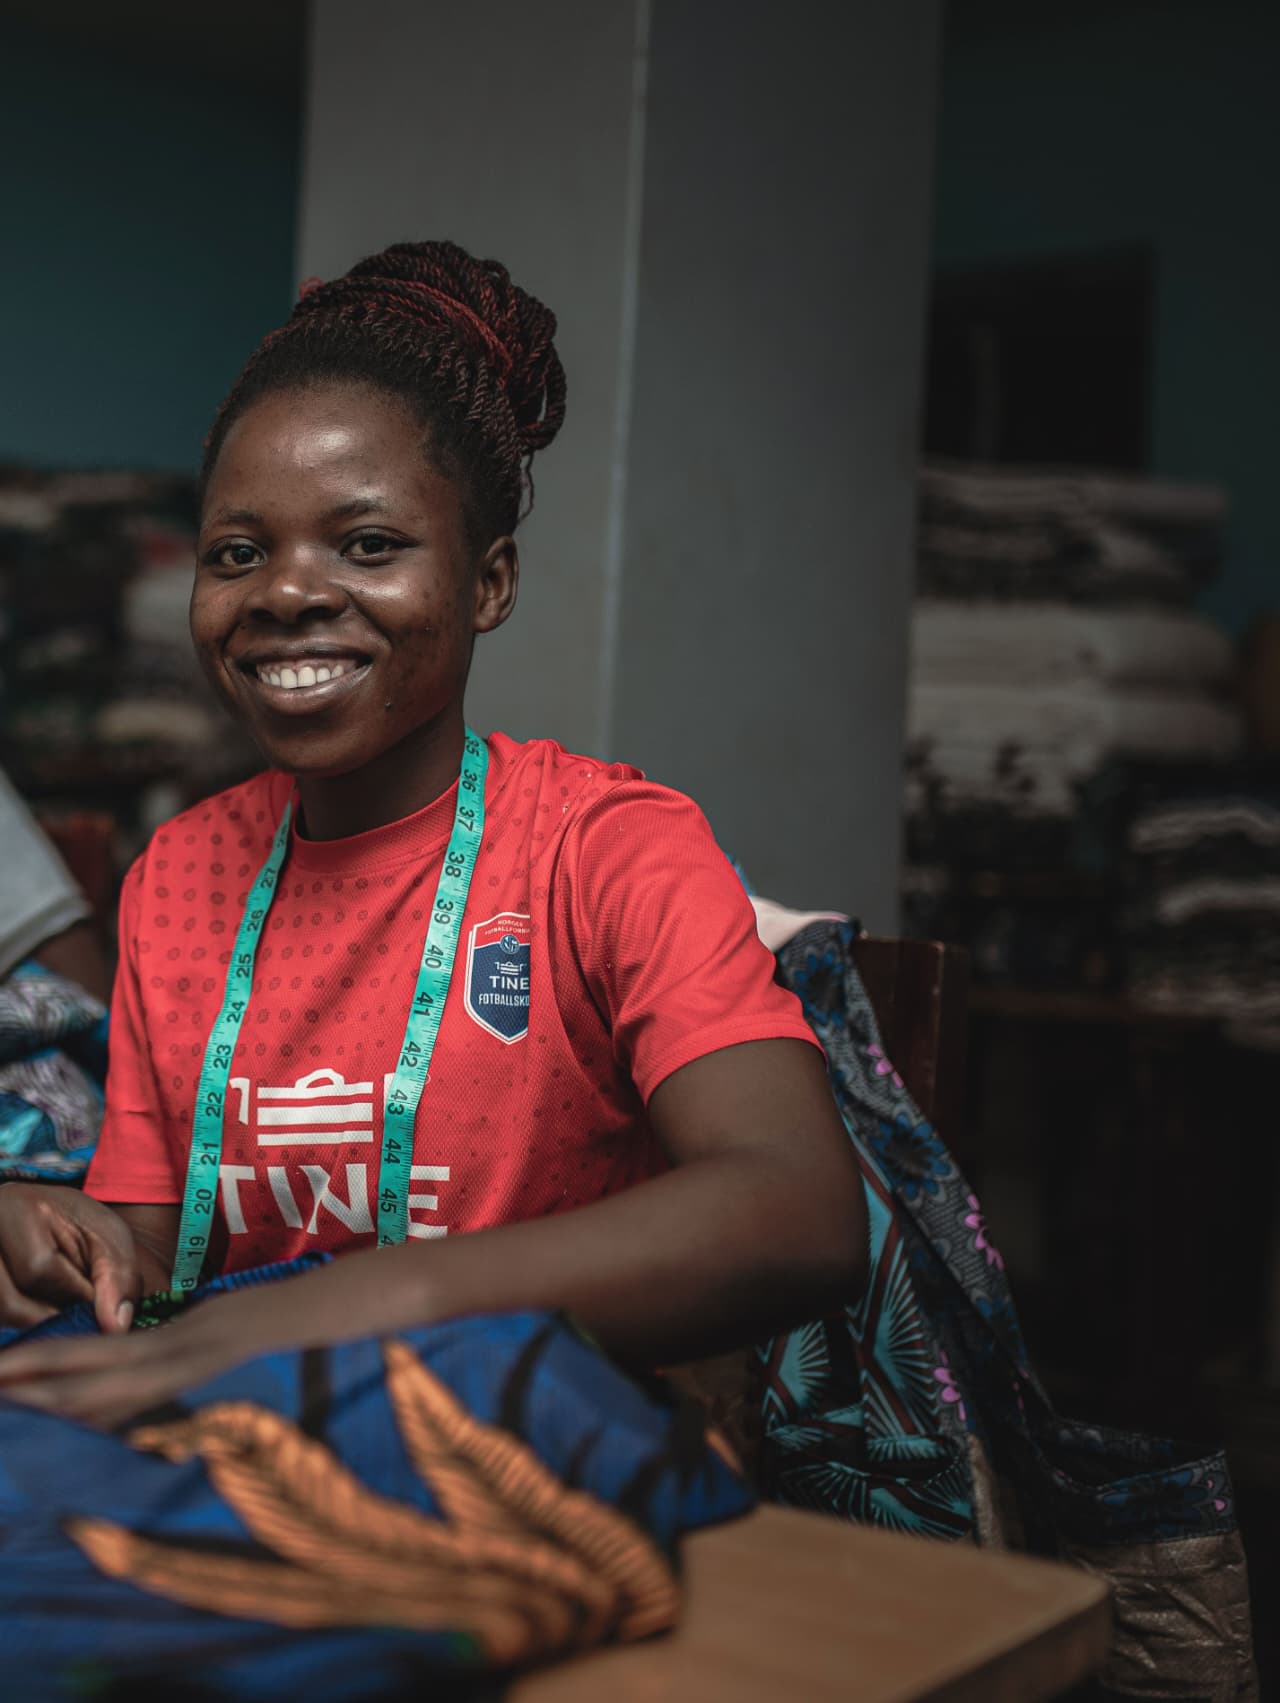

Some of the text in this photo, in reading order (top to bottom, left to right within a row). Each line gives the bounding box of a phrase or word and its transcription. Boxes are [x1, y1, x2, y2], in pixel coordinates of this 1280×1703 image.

[462, 769, 478, 793] 36
[459, 806, 474, 832] 37
[445, 851, 465, 878] 38
[261, 868, 276, 888] 27
[247, 909, 264, 932] 26
[434, 899, 454, 925] 39
[236, 953, 252, 978] 25
[425, 944, 444, 969] 40
[489, 975, 529, 990] TINE
[227, 1001, 245, 1023] 24
[414, 991, 434, 1018] 41
[213, 1044, 231, 1070] 23
[400, 1041, 421, 1068] 42
[206, 1091, 222, 1118] 22
[387, 1089, 408, 1116] 43
[201, 1142, 219, 1166] 21
[384, 1138, 401, 1165] 44
[194, 1189, 213, 1214] 20
[218, 1163, 451, 1240] TINE
[381, 1187, 397, 1214] 45
[187, 1236, 205, 1258] 19
